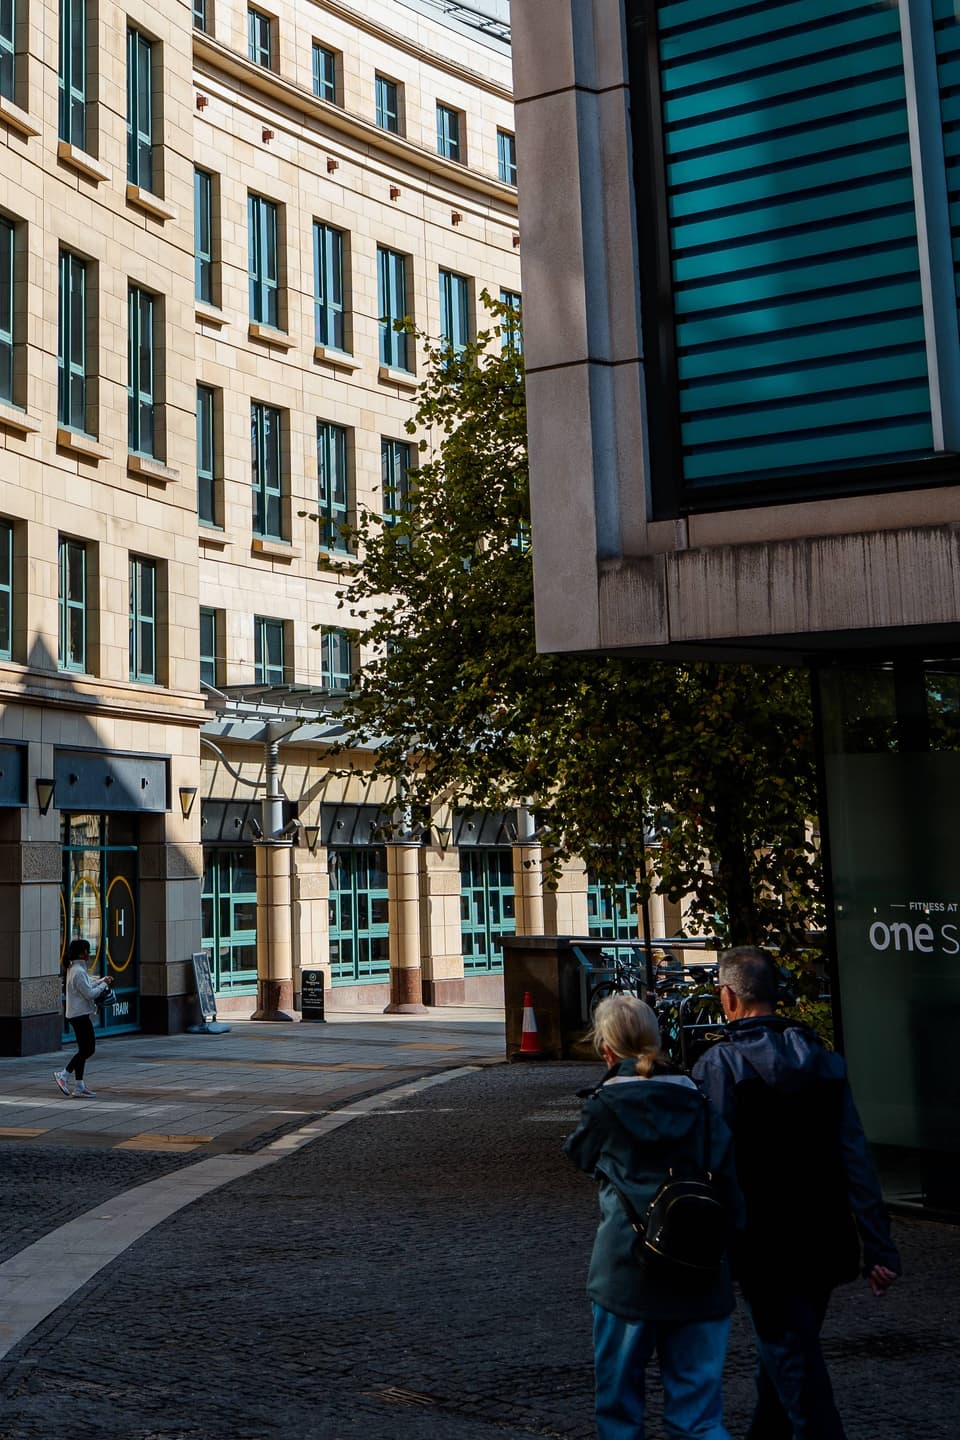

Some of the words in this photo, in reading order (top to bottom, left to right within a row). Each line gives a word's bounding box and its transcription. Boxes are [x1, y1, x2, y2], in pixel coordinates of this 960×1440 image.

[909, 901, 945, 912] FITNESS
[946, 903, 958, 912] AT
[869, 921, 934, 953] one
[112, 1001, 129, 1017] TRAIN
